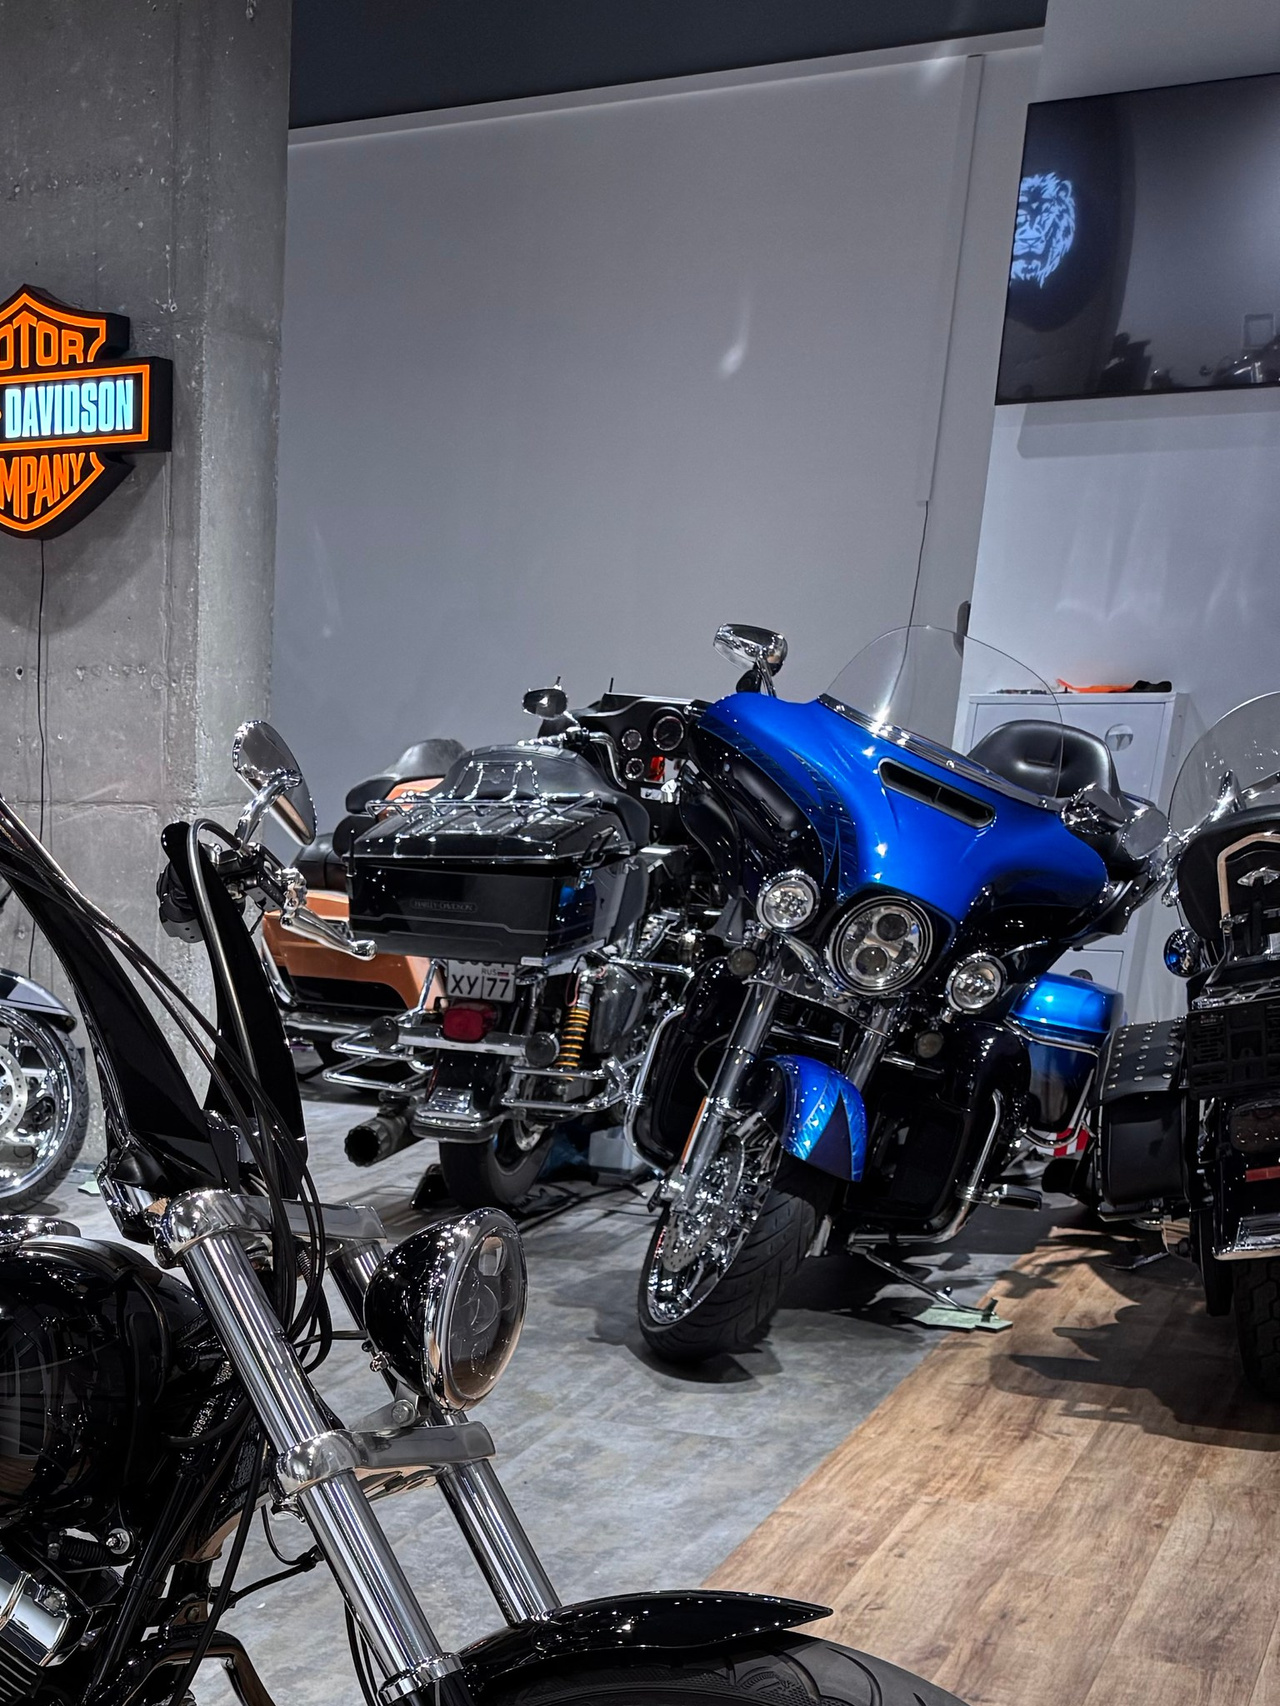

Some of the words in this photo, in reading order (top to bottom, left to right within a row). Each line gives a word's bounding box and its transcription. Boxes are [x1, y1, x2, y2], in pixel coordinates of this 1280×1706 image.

[5, 379, 134, 438] DAVIDSON
[481, 967, 498, 976] RUS
[486, 977, 511, 998] 77
